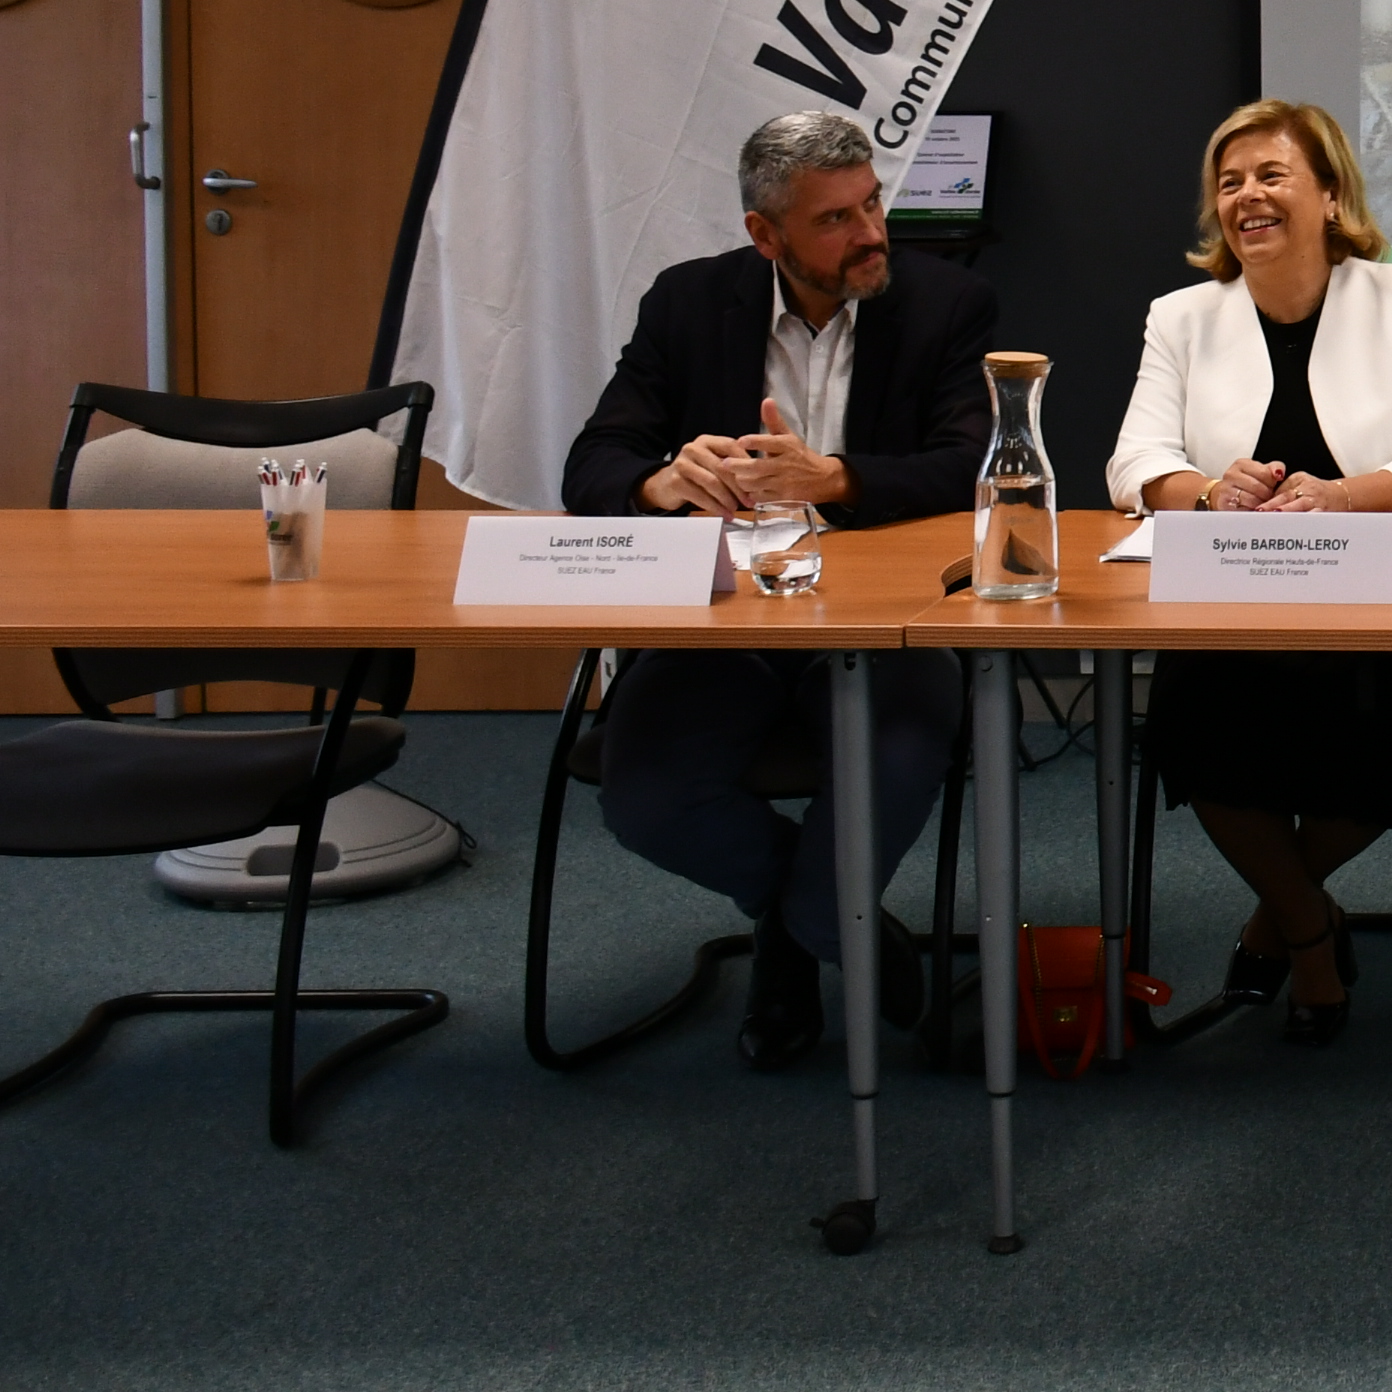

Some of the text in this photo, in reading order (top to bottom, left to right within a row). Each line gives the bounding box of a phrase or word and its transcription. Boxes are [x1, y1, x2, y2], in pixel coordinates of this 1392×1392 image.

[549, 533, 635, 548] Laurent ISORÉ
[1212, 538, 1350, 552] Sylvie BARBON-LEROY
[549, 554, 573, 563] Agence
[1220, 557, 1251, 565] Directrice
[1286, 557, 1339, 565] Hauts-de-France
